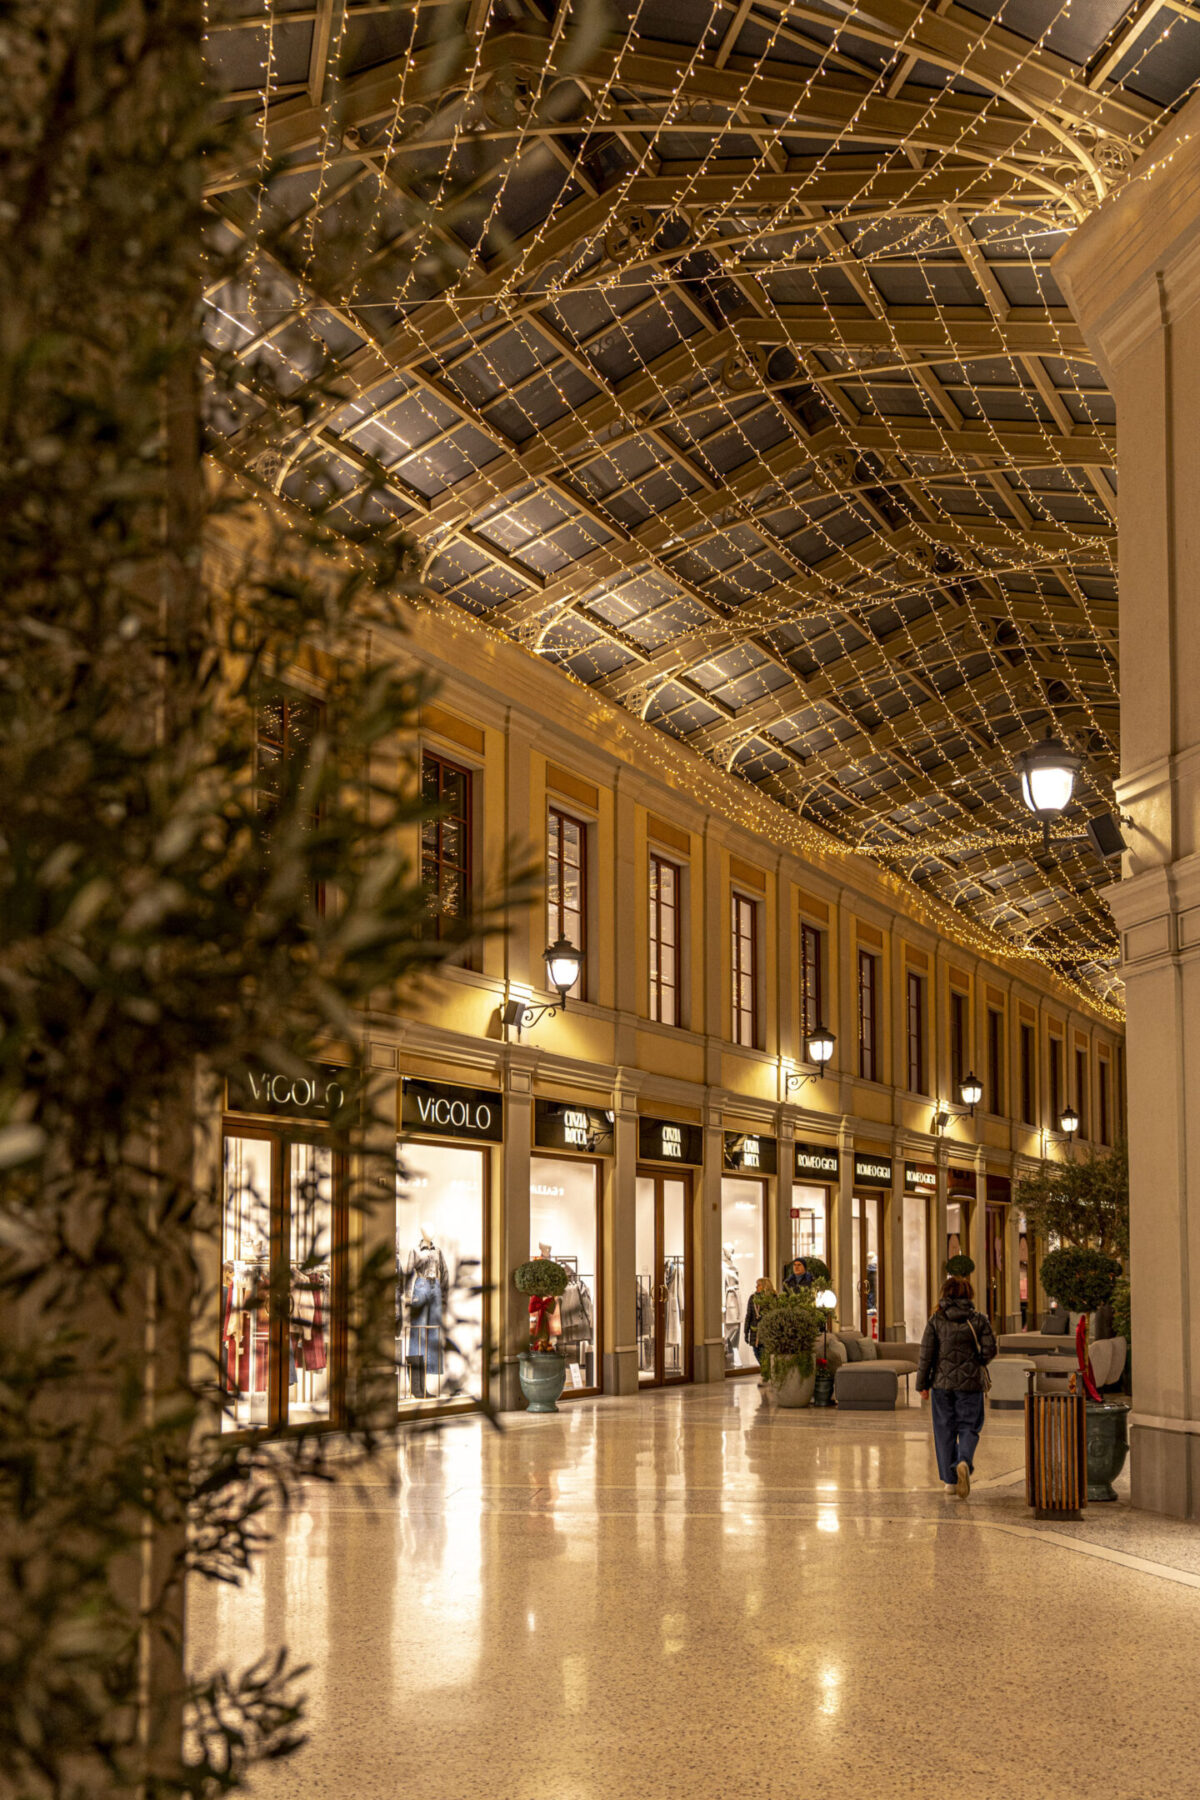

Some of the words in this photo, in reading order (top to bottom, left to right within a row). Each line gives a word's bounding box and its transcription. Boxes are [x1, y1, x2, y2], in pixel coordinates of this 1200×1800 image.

[797, 1154, 820, 1169] ROMEO
[821, 1157, 837, 1171] GIGLI
[856, 1163, 877, 1177] ROMEO
[906, 1170, 923, 1183] ROMEO
